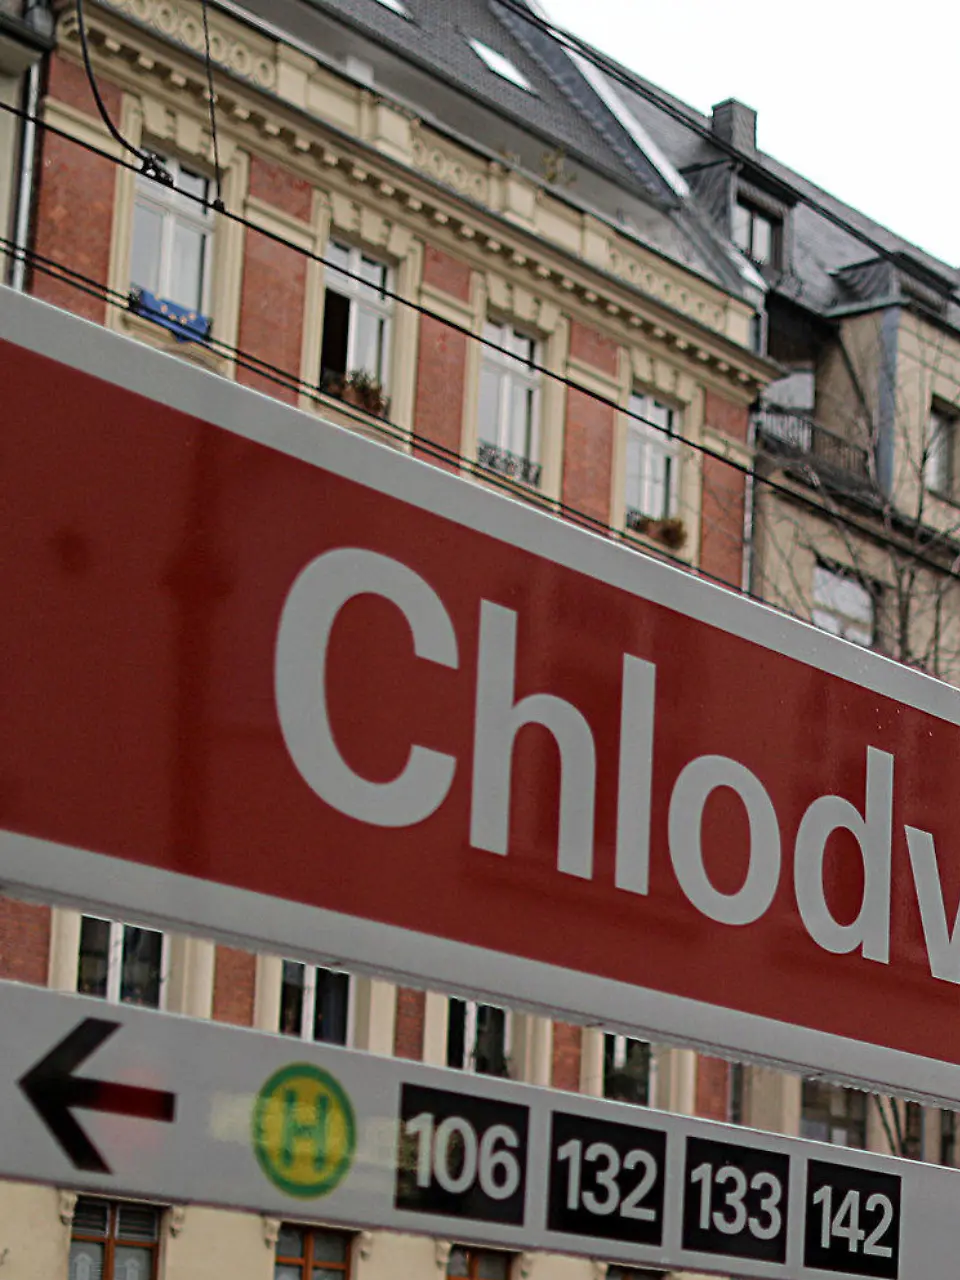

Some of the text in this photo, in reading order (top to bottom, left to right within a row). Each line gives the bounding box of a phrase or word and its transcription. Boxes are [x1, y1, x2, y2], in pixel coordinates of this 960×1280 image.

[405, 1112, 893, 1258] 106 132 133 142
